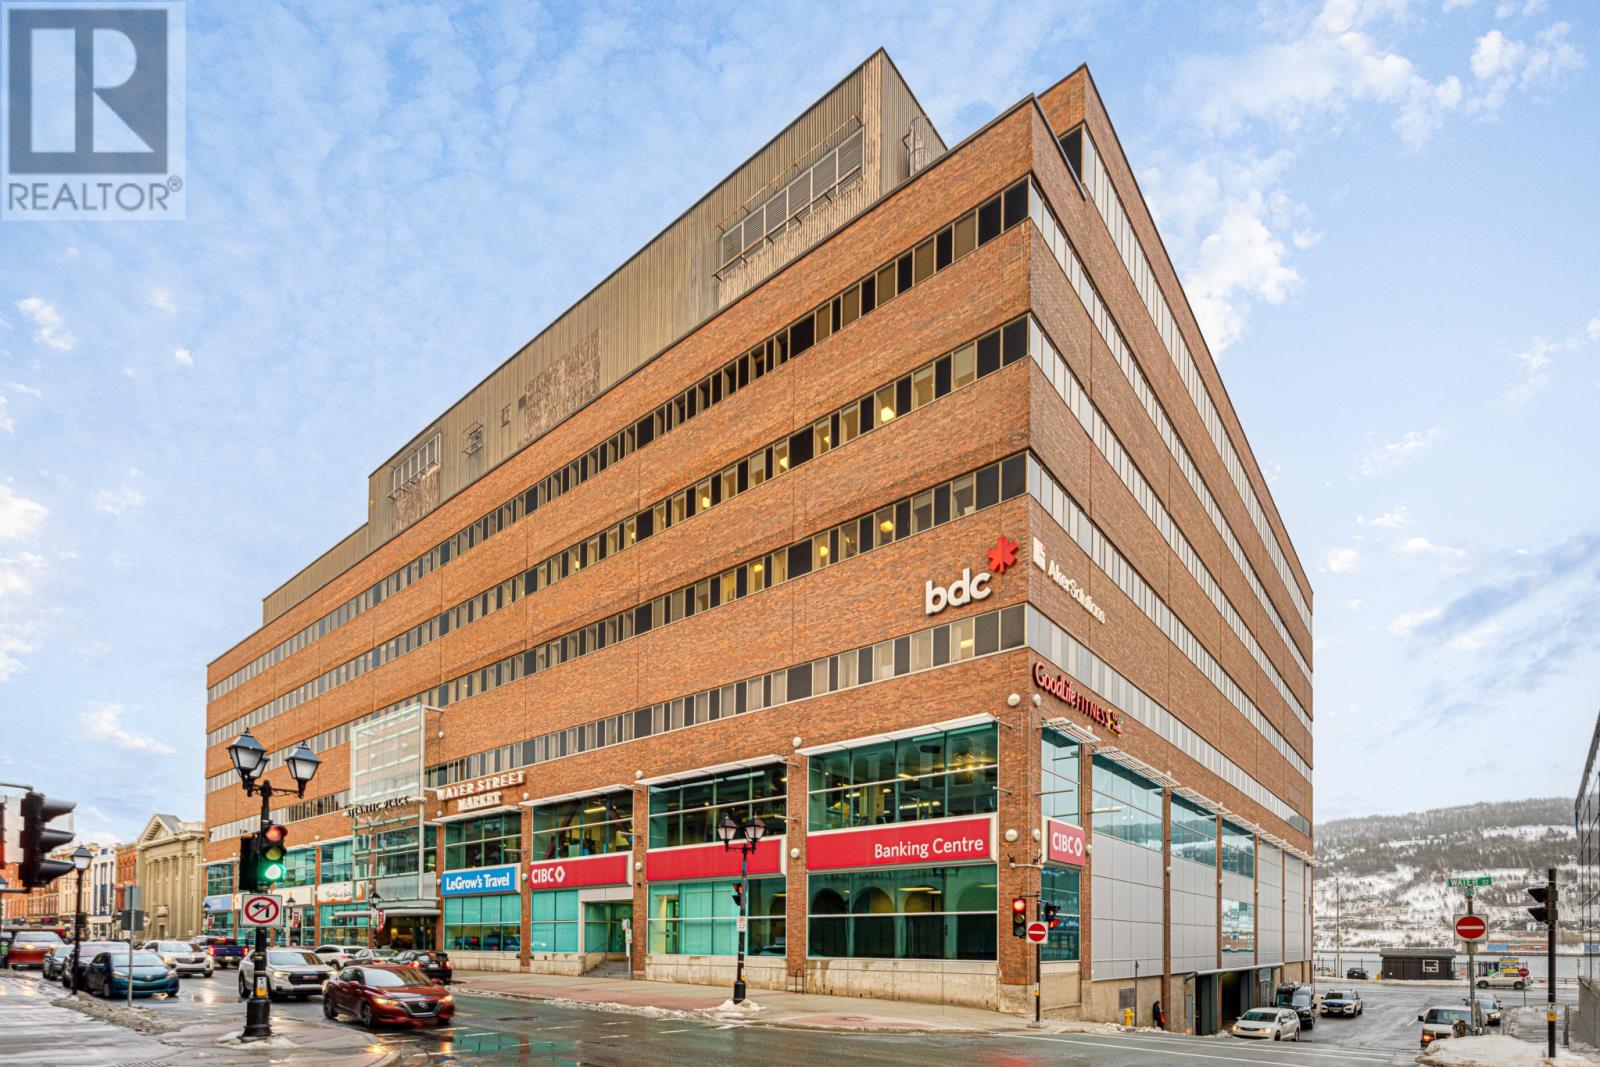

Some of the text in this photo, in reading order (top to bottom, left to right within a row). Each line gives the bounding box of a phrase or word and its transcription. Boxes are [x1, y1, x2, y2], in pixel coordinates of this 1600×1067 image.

[925, 567, 993, 615] bdc
[436, 770, 526, 801] WATER STREET
[457, 791, 502, 811] MARKET
[874, 837, 984, 858] Banking Centre
[1052, 831, 1074, 854] CIBC
[446, 872, 510, 890] LeGrow's Travel
[531, 867, 555, 884] CIBC
